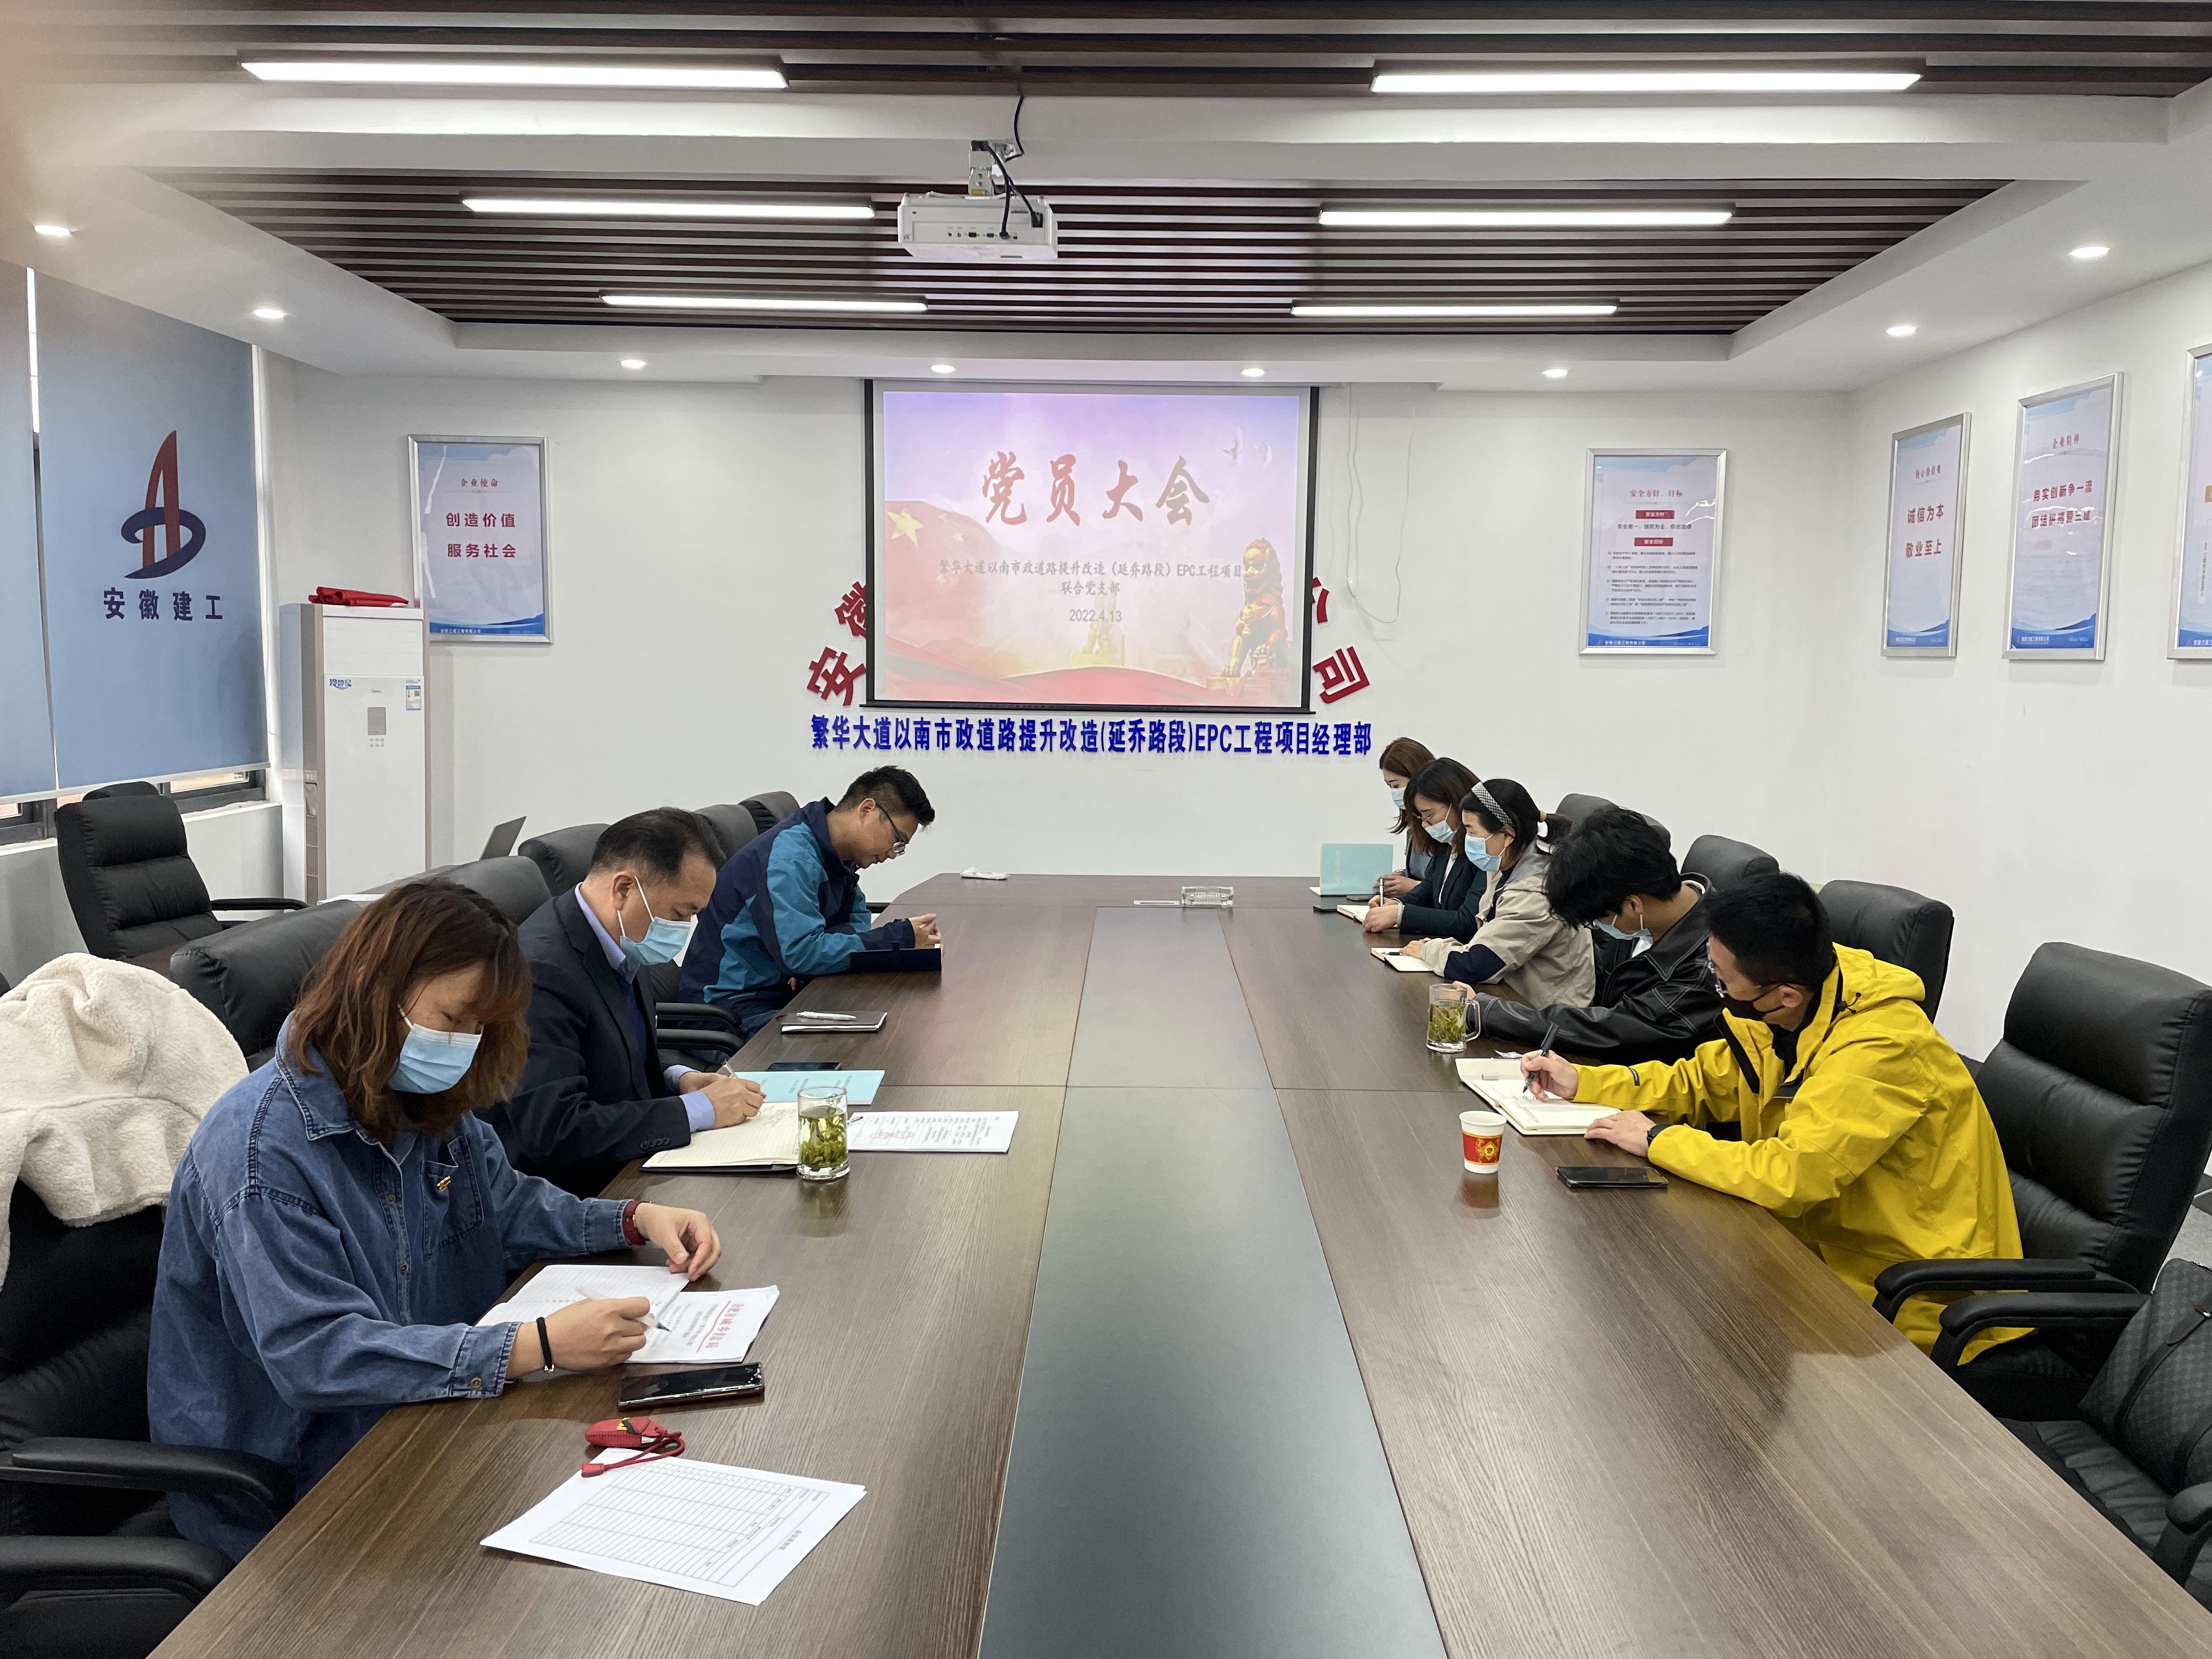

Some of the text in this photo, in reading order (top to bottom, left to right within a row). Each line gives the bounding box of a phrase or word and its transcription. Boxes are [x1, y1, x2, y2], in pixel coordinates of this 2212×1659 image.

[461, 478, 498, 487] 企业使命
[982, 451, 1210, 527] 党员大会
[2033, 479, 2092, 502] 务实创新争一流
[445, 512, 516, 528] 创造价值
[1908, 503, 1944, 524] 诚信为本
[447, 543, 516, 558] 服务社会
[1905, 539, 1942, 558] 敬业至上
[1060, 580, 1120, 596] 联合党支部
[103, 586, 223, 621] 安徽建工
[1069, 609, 1122, 623] 2022.4.13
